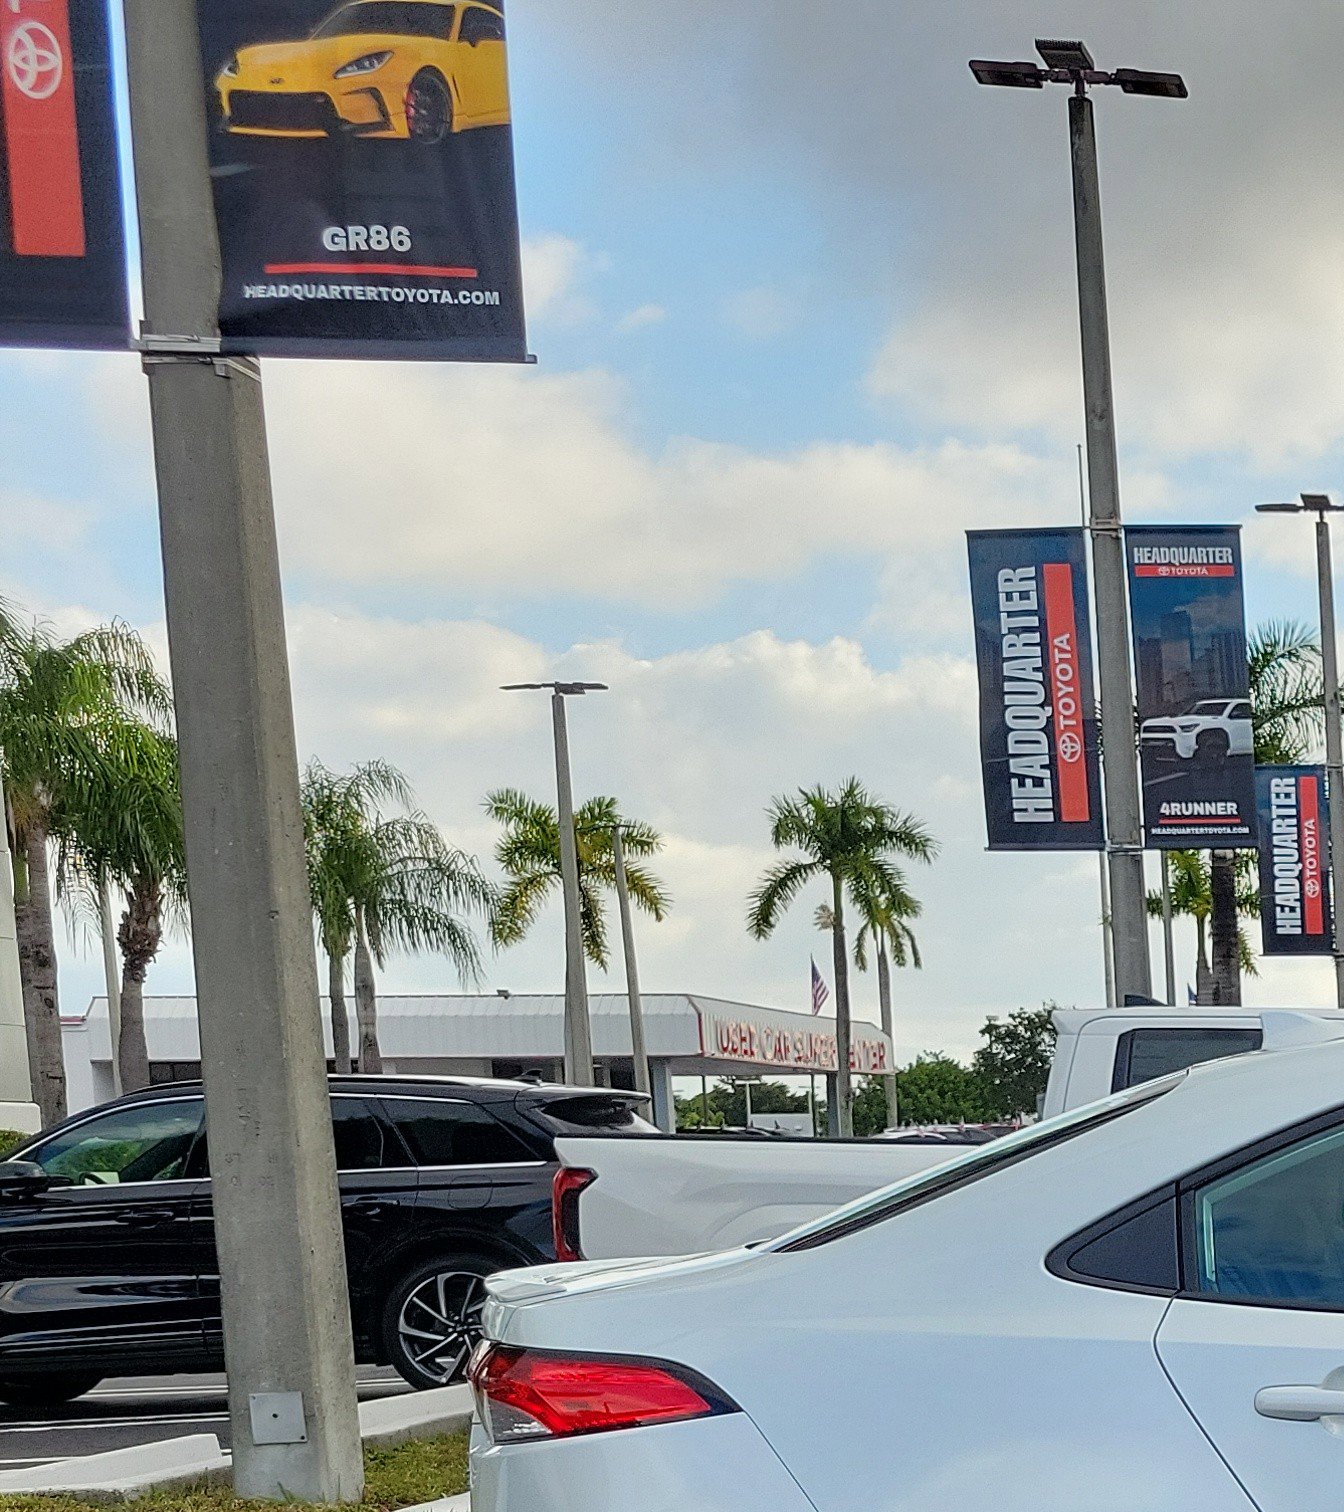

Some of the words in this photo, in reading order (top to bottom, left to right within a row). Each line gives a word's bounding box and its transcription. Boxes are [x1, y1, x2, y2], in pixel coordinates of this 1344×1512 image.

[322, 225, 412, 251] GR86
[243, 284, 501, 306] HEADQUARTERTOYOTA.COM
[1133, 547, 1233, 566] HEADQUARTER
[1171, 566, 1209, 576] TOYOTA
[997, 566, 1055, 822] HEADQUARTER
[1053, 633, 1077, 729] TOYOTA
[1160, 802, 1238, 816] 4RUNNER
[1270, 777, 1302, 934] HEADQUARTER
[1305, 818, 1318, 877] TOYOTA
